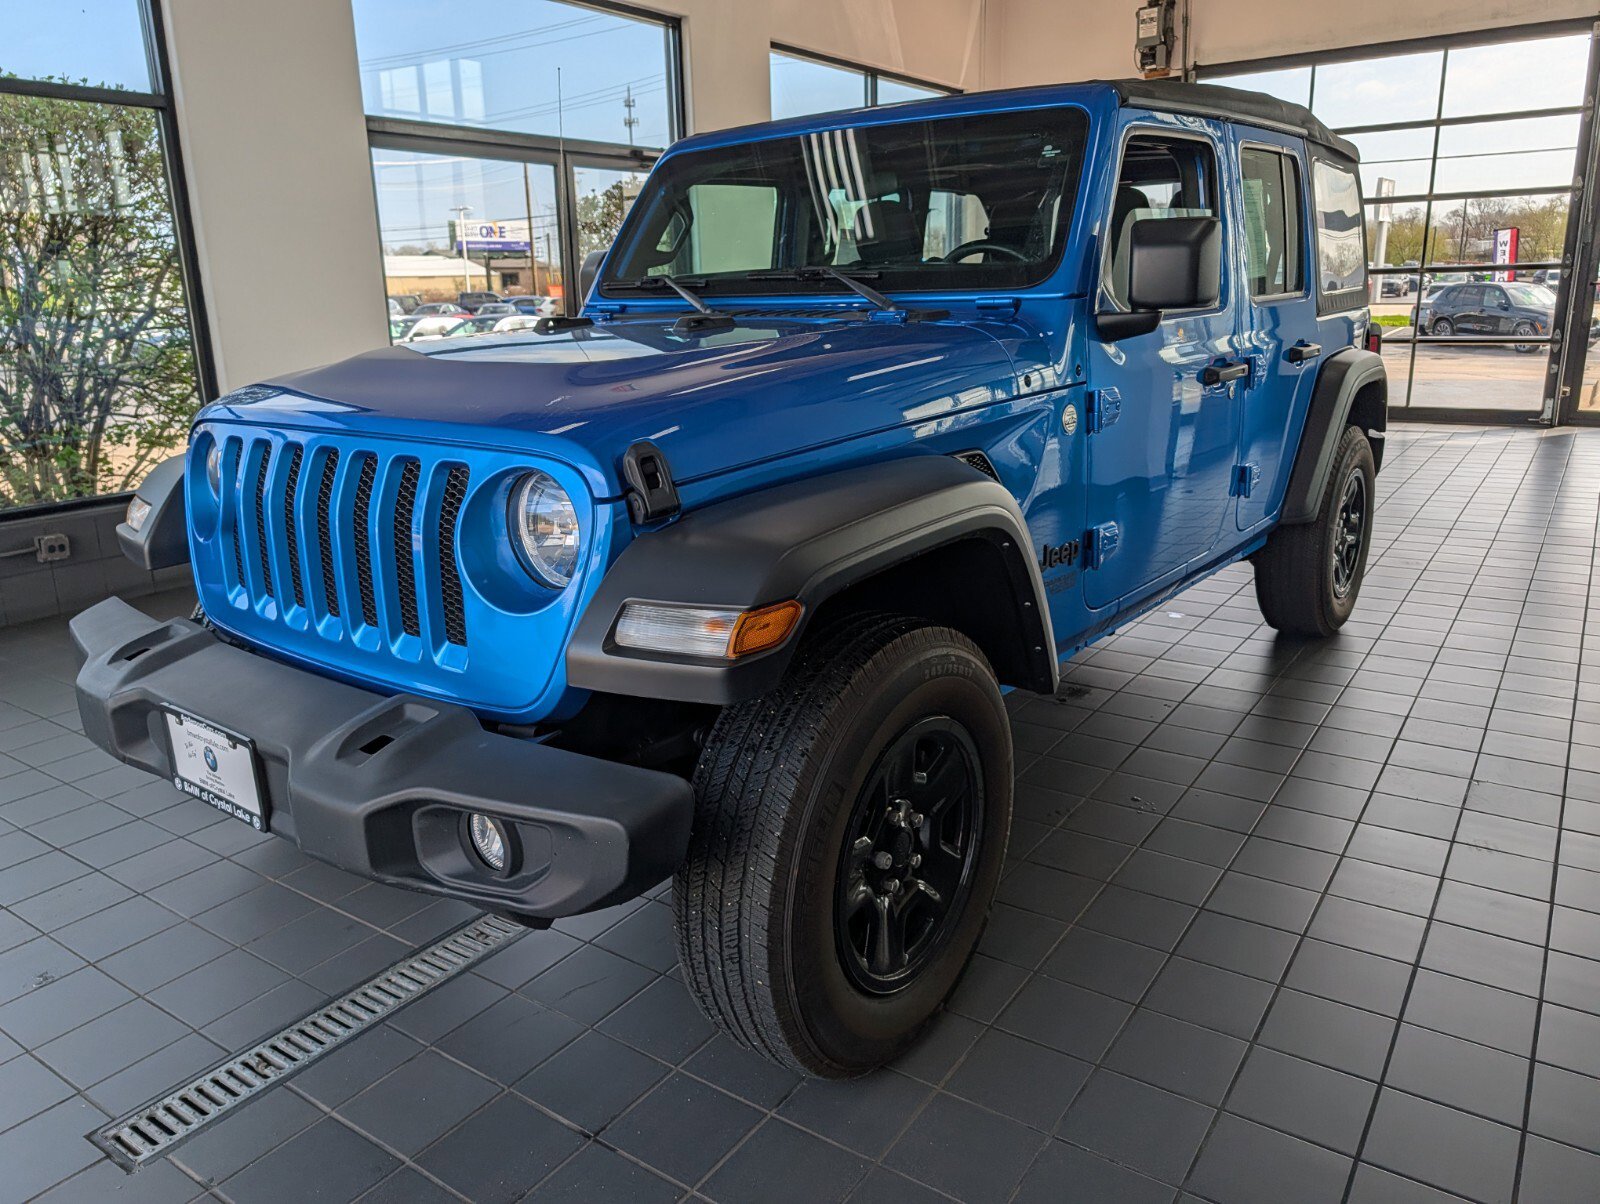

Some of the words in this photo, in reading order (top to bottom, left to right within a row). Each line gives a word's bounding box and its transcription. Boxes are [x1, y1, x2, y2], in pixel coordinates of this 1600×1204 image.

[1041, 538, 1079, 571] Jeep
[183, 781, 200, 797] BMW
[201, 791, 209, 800] of
[209, 793, 232, 813] Crystal
[233, 805, 251, 822] Lake
